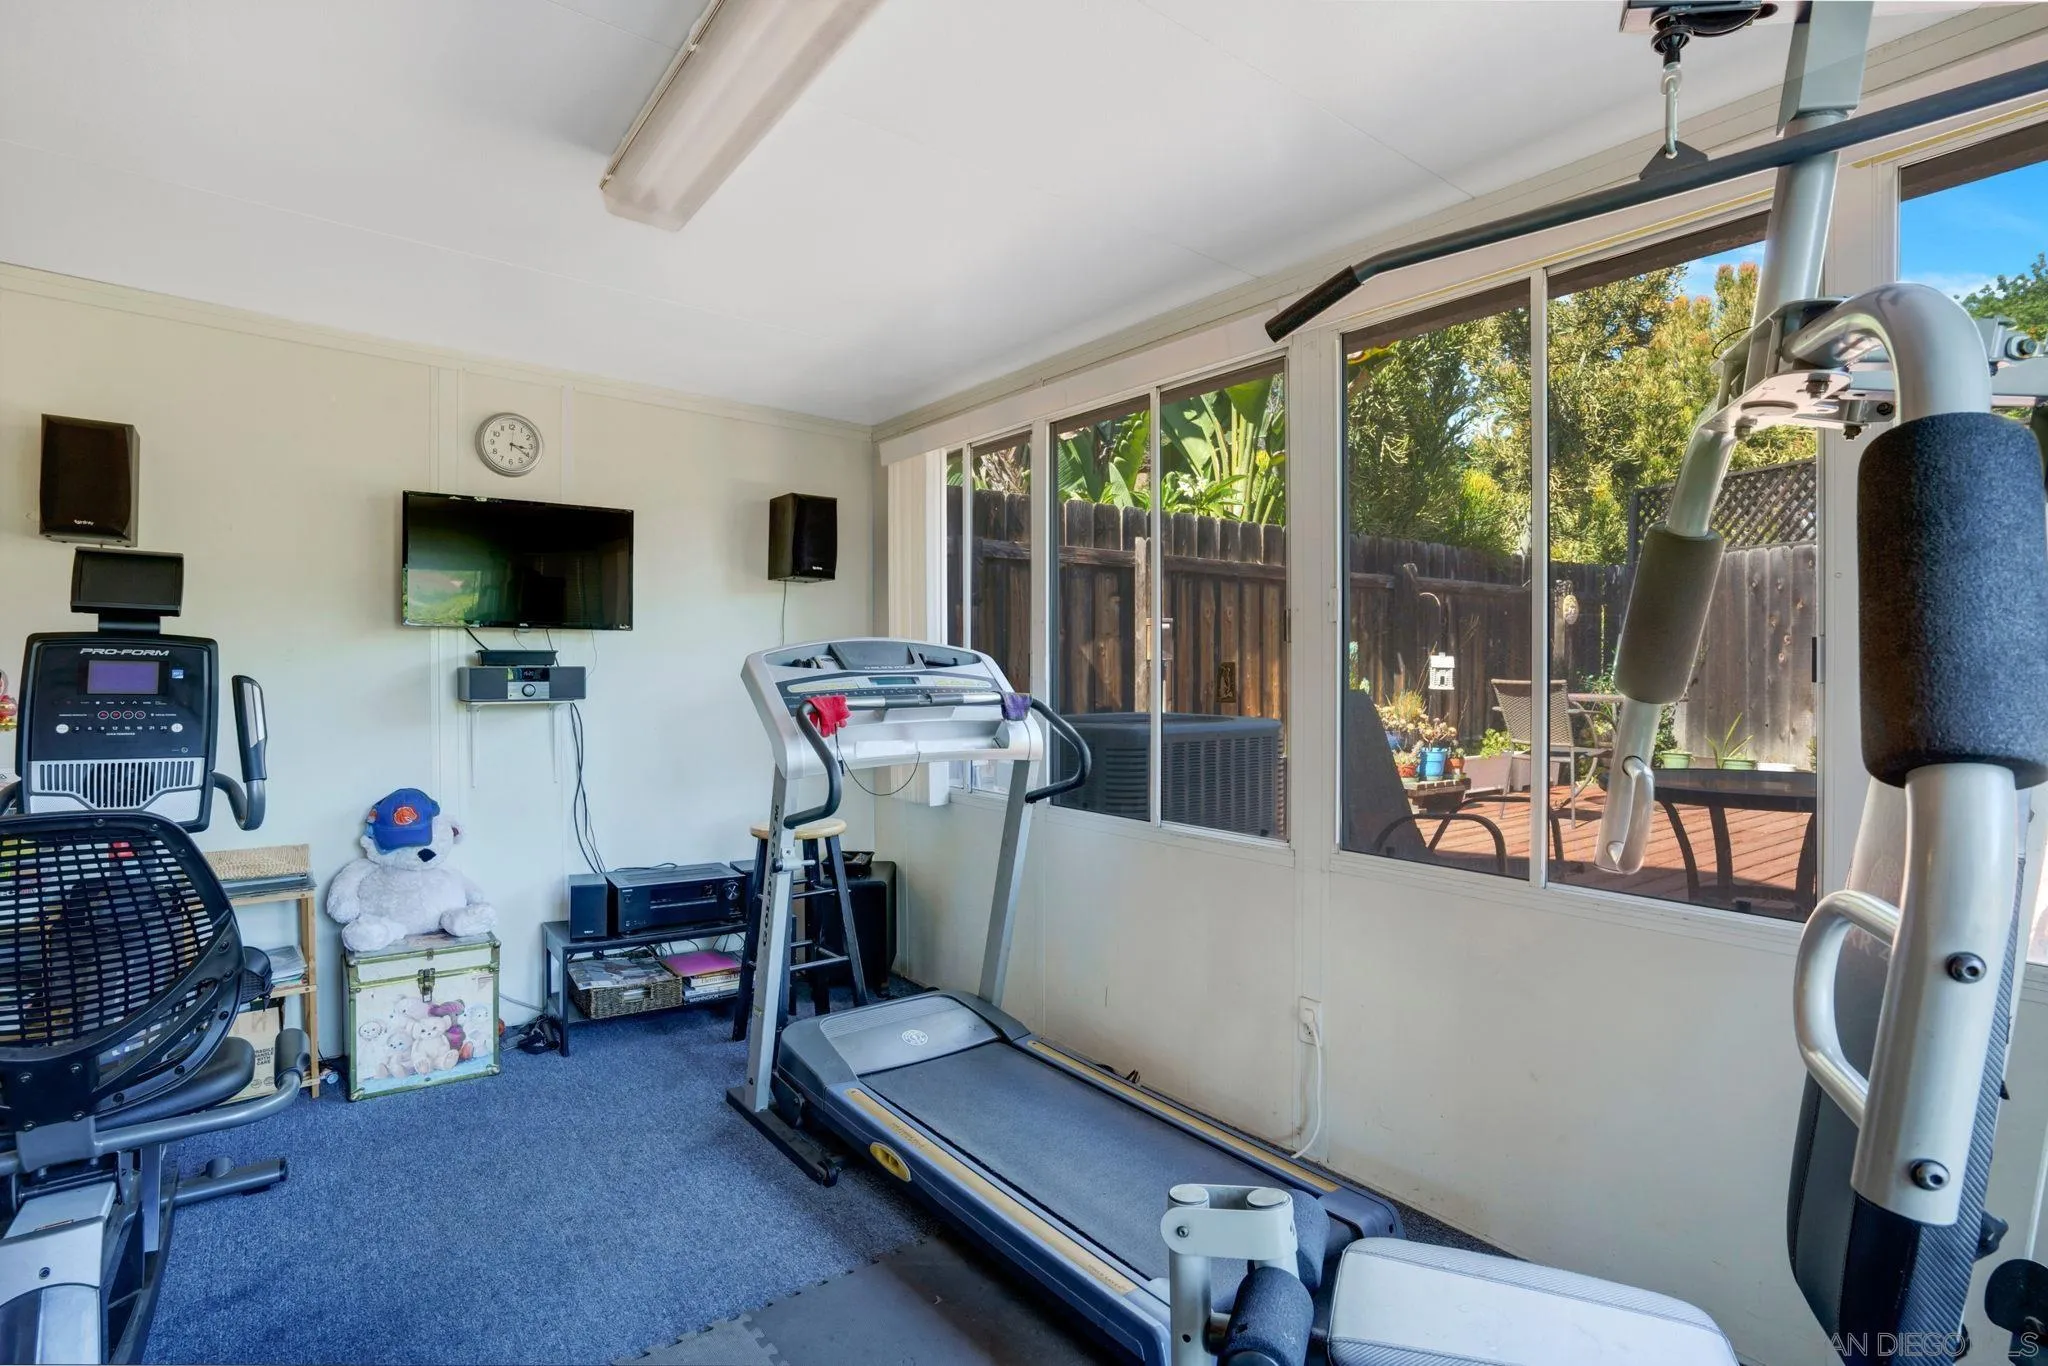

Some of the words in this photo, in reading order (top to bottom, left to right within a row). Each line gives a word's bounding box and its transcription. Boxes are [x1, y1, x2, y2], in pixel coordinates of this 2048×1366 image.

[509, 423, 515, 431] 12
[493, 430, 500, 438] 10
[490, 438, 495, 446] 9
[80, 648, 170, 656] PRO-FORM
